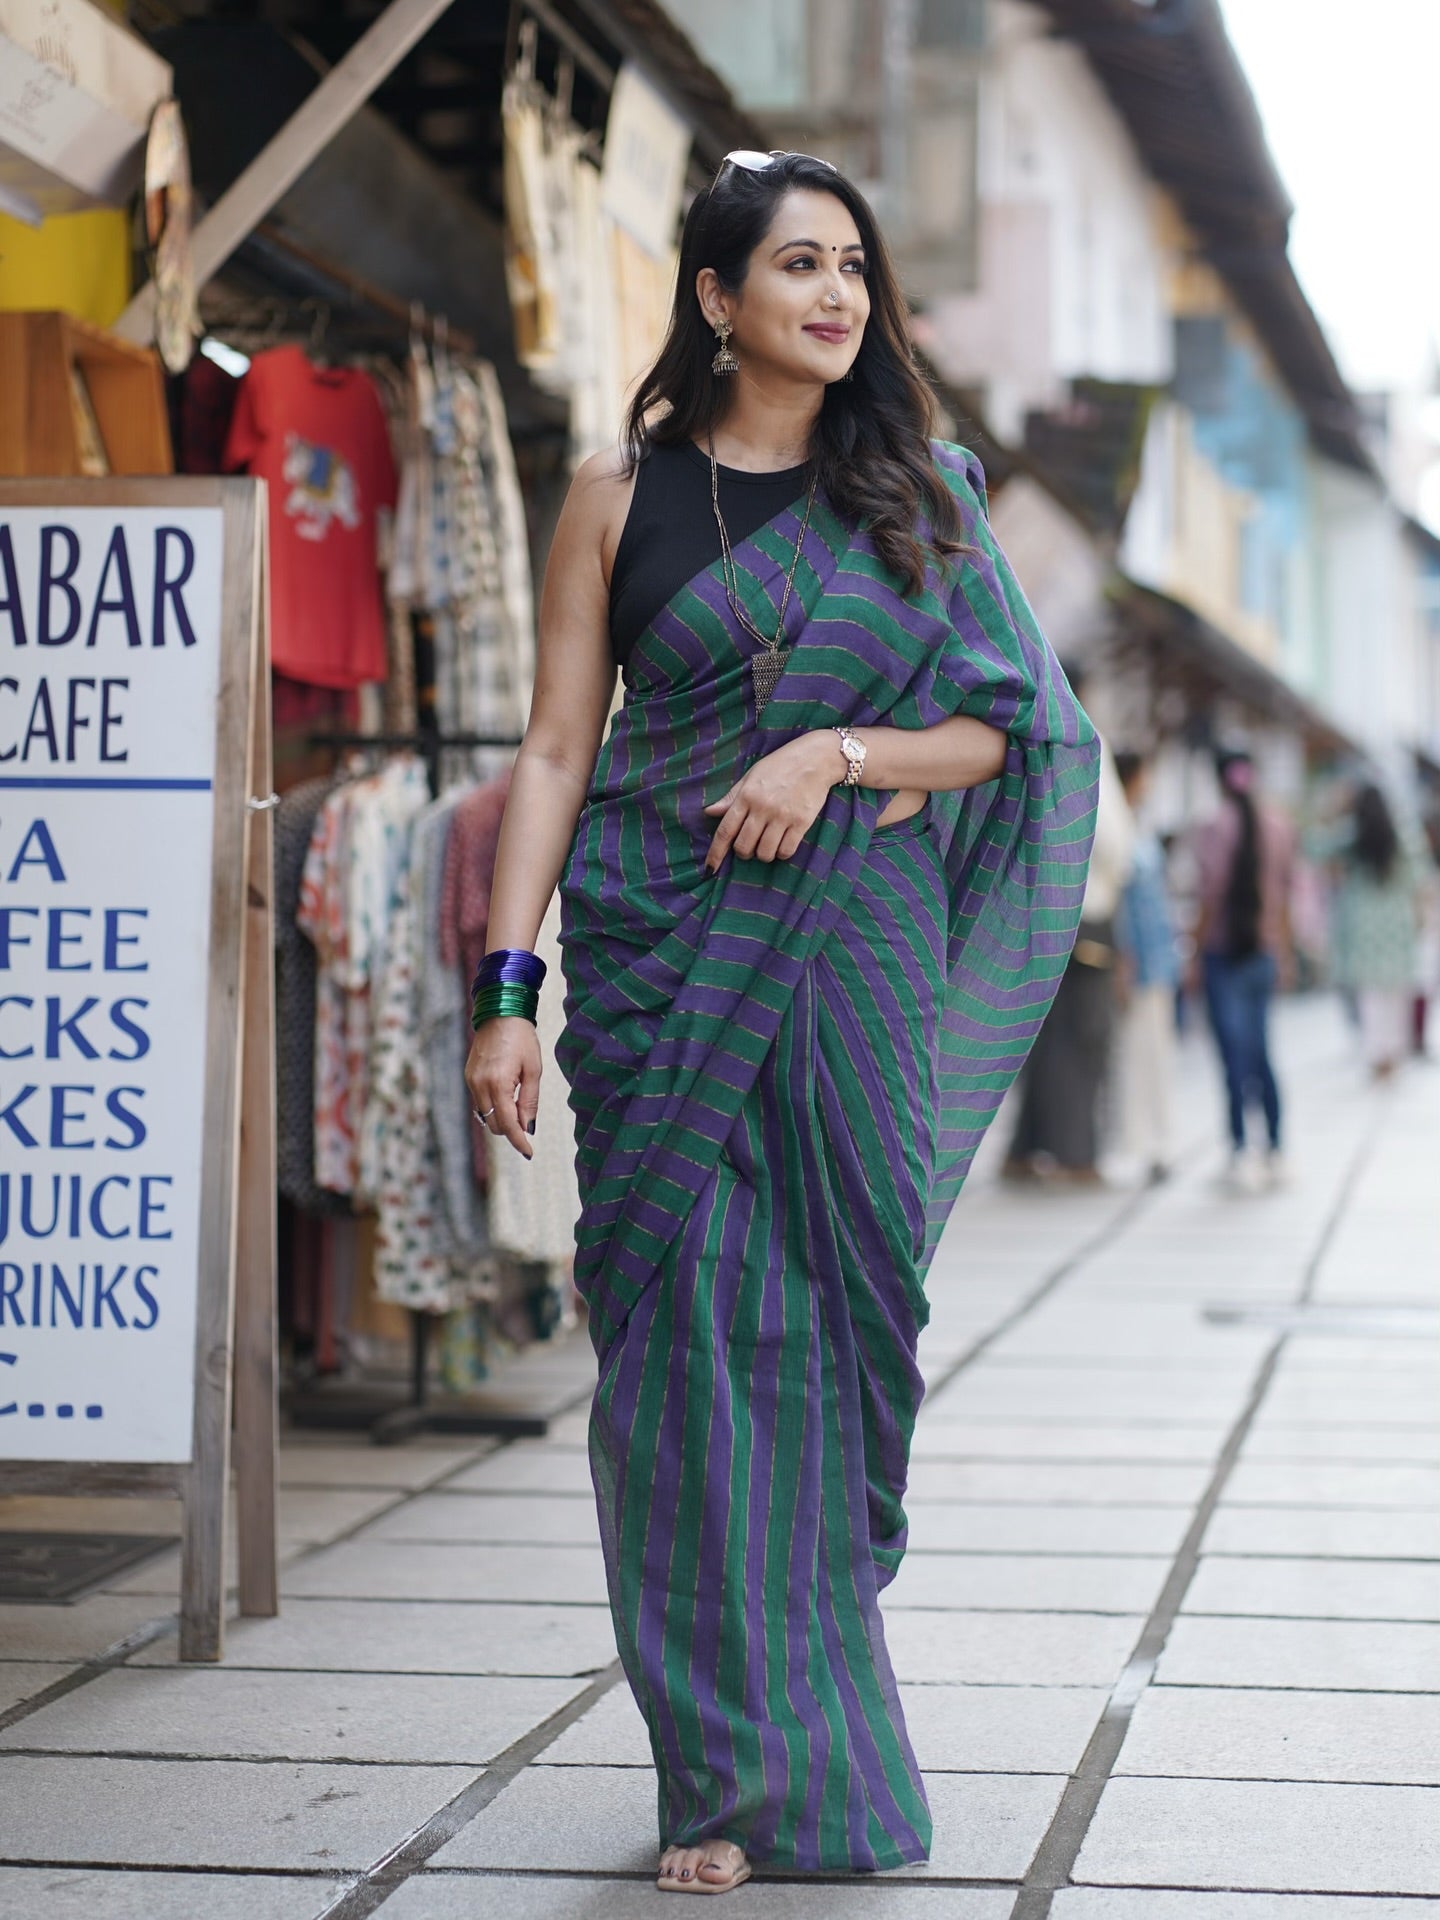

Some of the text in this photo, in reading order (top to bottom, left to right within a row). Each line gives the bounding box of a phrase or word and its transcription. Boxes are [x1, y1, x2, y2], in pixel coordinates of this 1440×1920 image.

[0, 907, 149, 972] FEE
[0, 1084, 147, 1151] KES
[0, 1173, 173, 1246] JUICE
[0, 1262, 159, 1331] RINKS
